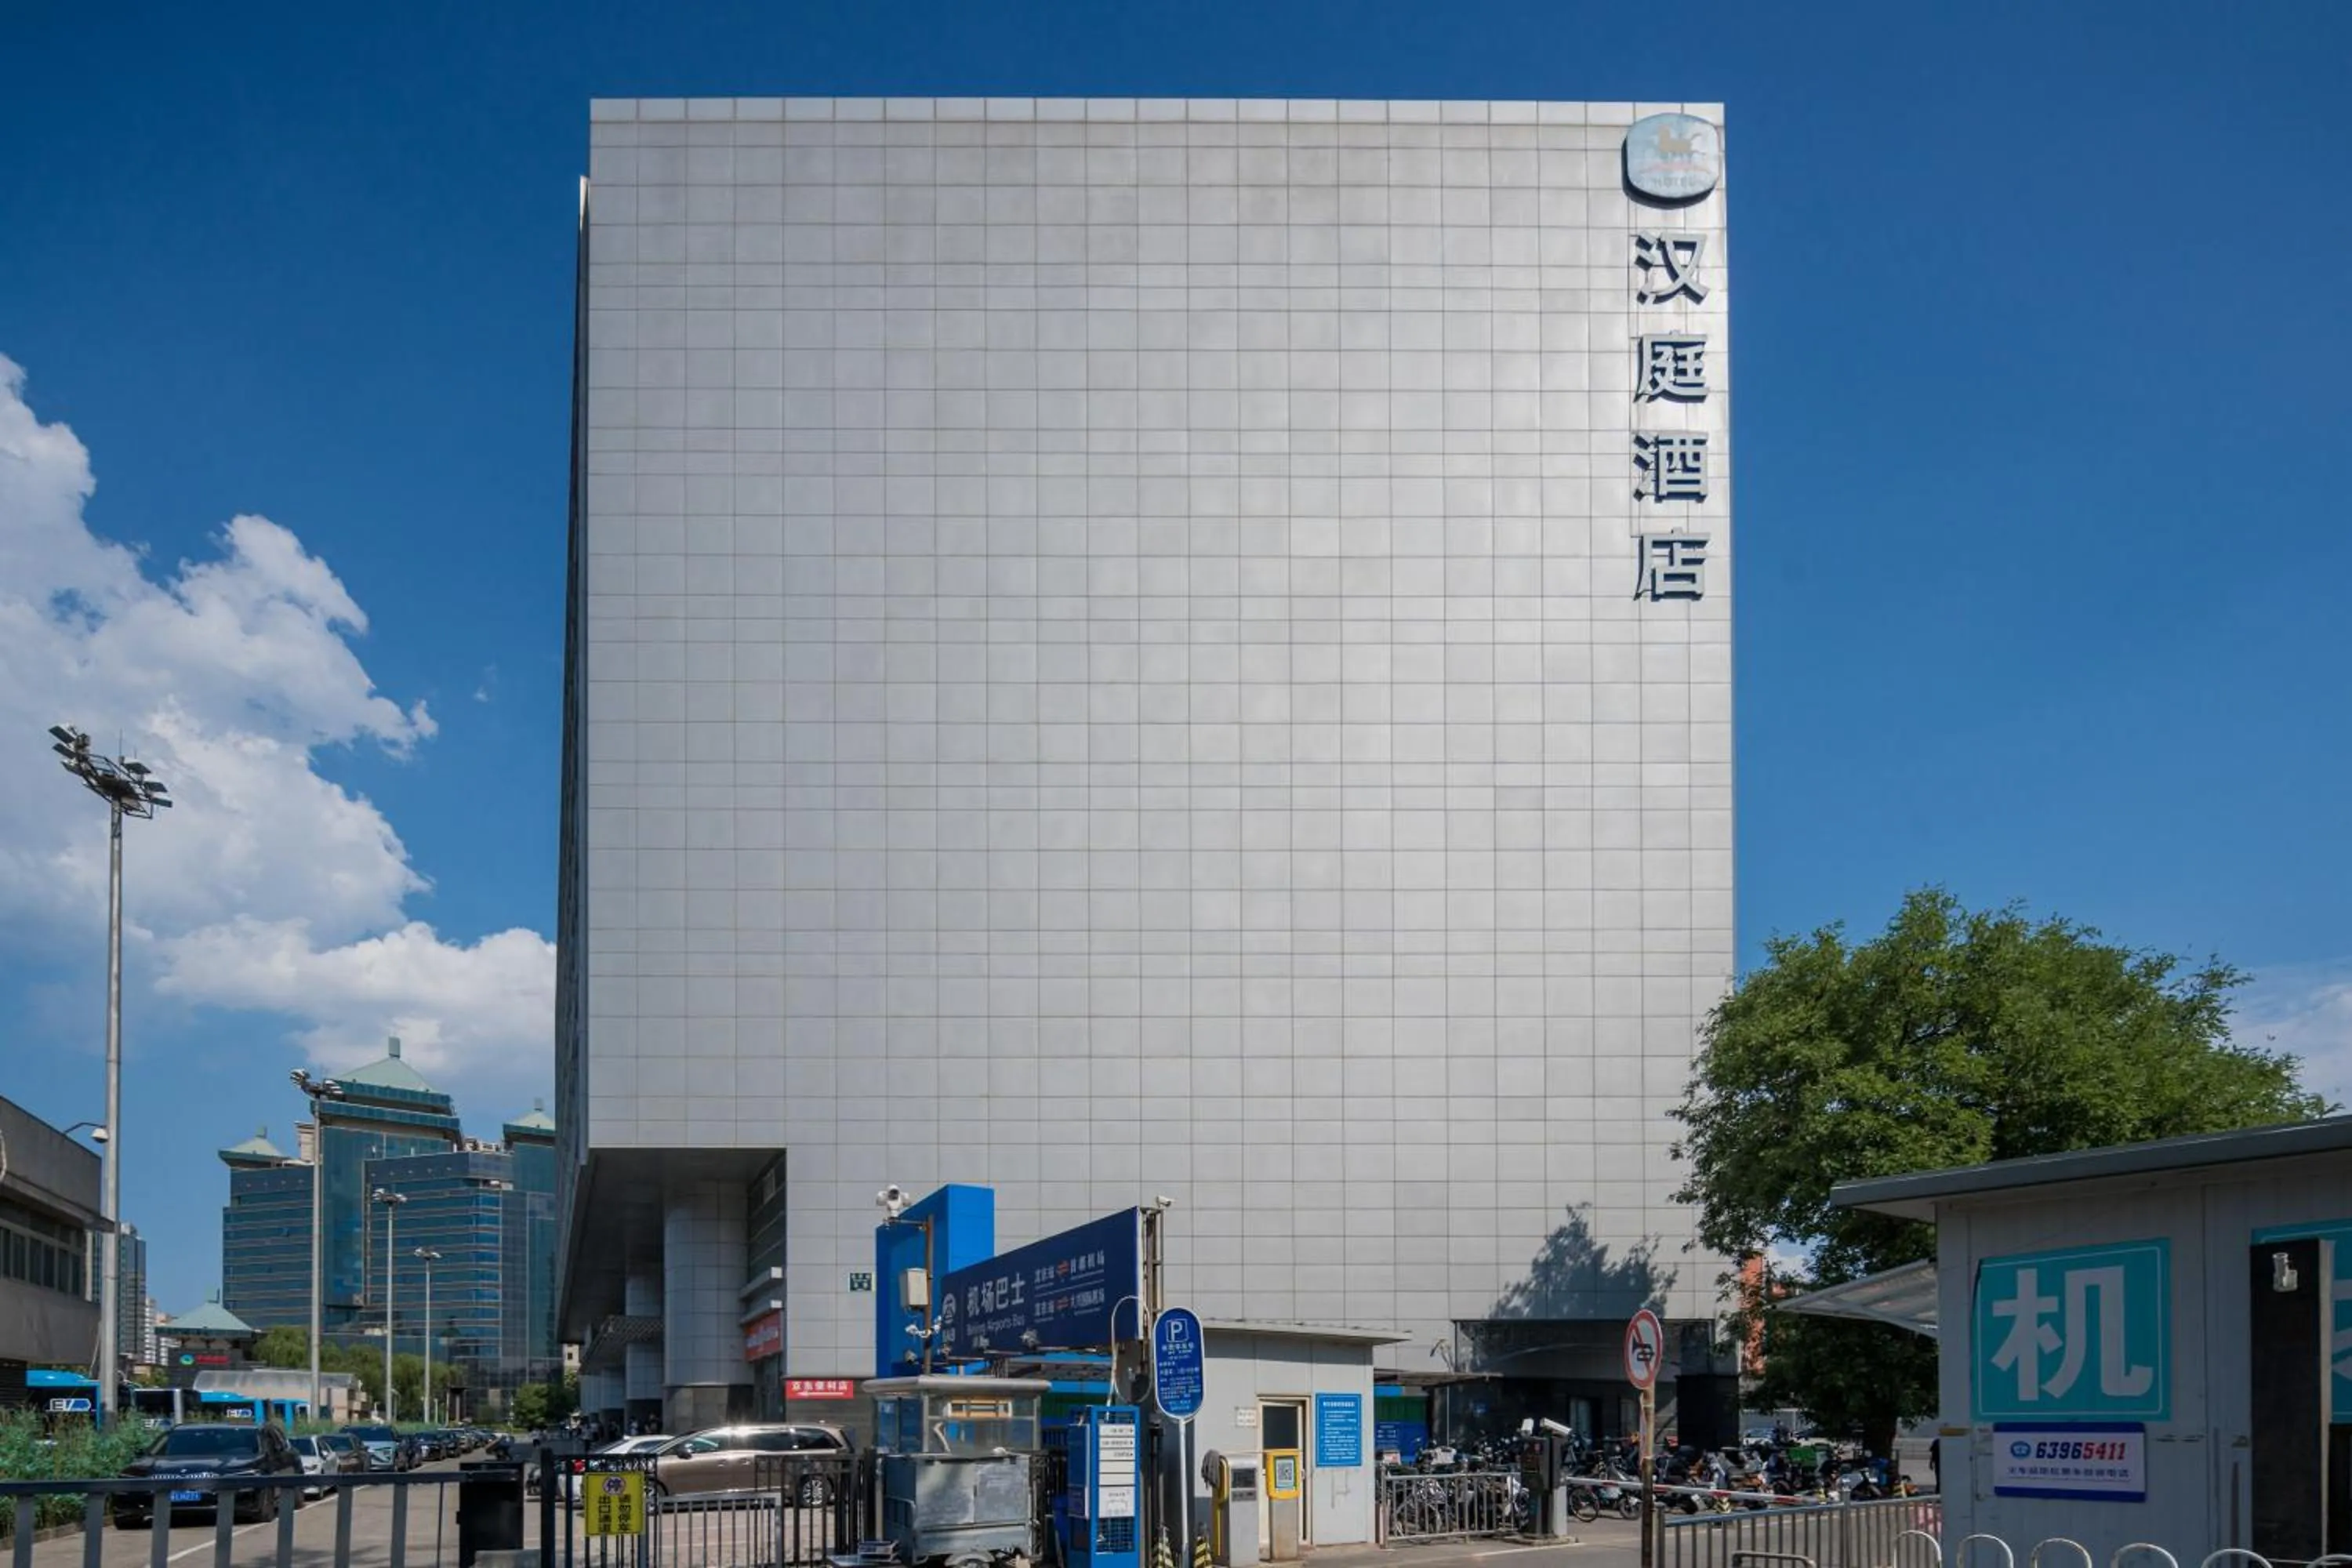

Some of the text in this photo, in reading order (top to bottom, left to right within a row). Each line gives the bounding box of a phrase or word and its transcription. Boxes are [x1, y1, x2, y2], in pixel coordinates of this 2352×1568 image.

[1633, 233, 1711, 601] 汉庭酒店
[966, 1272, 1026, 1318] 机场巴士
[1171, 1321, 1183, 1341] P
[1991, 1264, 2154, 1402] 机
[2035, 1441, 2126, 1461] 63965411
